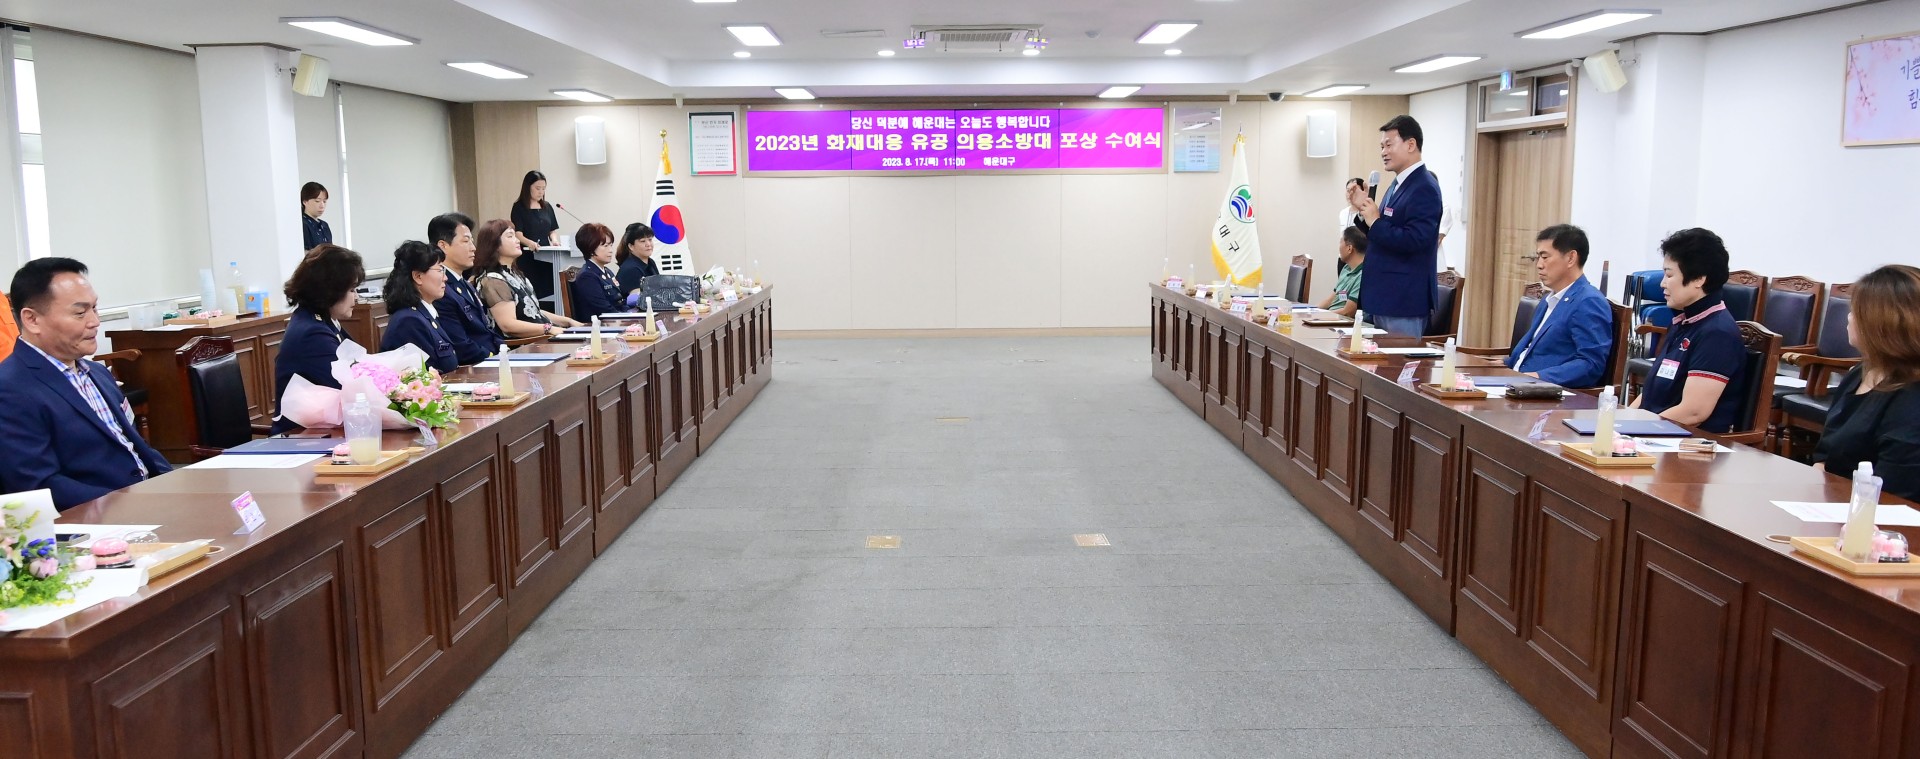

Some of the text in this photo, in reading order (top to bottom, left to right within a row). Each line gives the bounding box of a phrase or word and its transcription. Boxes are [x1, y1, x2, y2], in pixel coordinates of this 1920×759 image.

[1908, 88, 1920, 109] 힘
[851, 115, 1051, 130] 당신 덕분에 해운대는 오늘도 행복합니다
[755, 131, 1161, 151] 2023년 화재대응 유공 의용소방대 포상 수여식
[882, 157, 903, 167] 2023.
[904, 157, 913, 167] 8.
[943, 156, 966, 167] 11:00
[983, 156, 1016, 167] 해운대구
